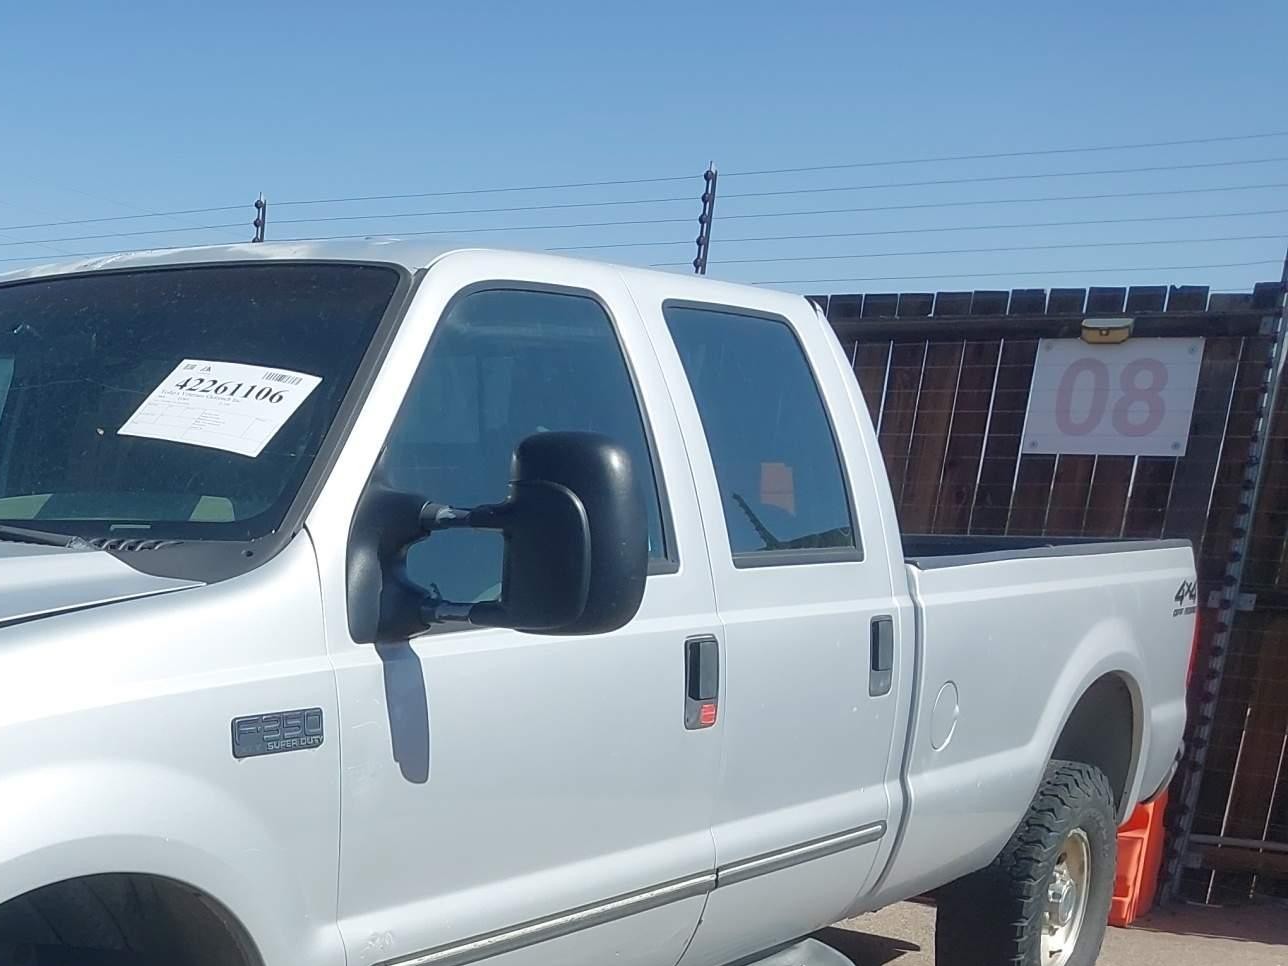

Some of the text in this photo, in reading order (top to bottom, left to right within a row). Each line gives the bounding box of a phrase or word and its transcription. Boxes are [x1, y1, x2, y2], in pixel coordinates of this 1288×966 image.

[174, 376, 289, 404] 42261106
[1055, 357, 1169, 438] 08
[266, 735, 324, 751] SUPER DUTY
